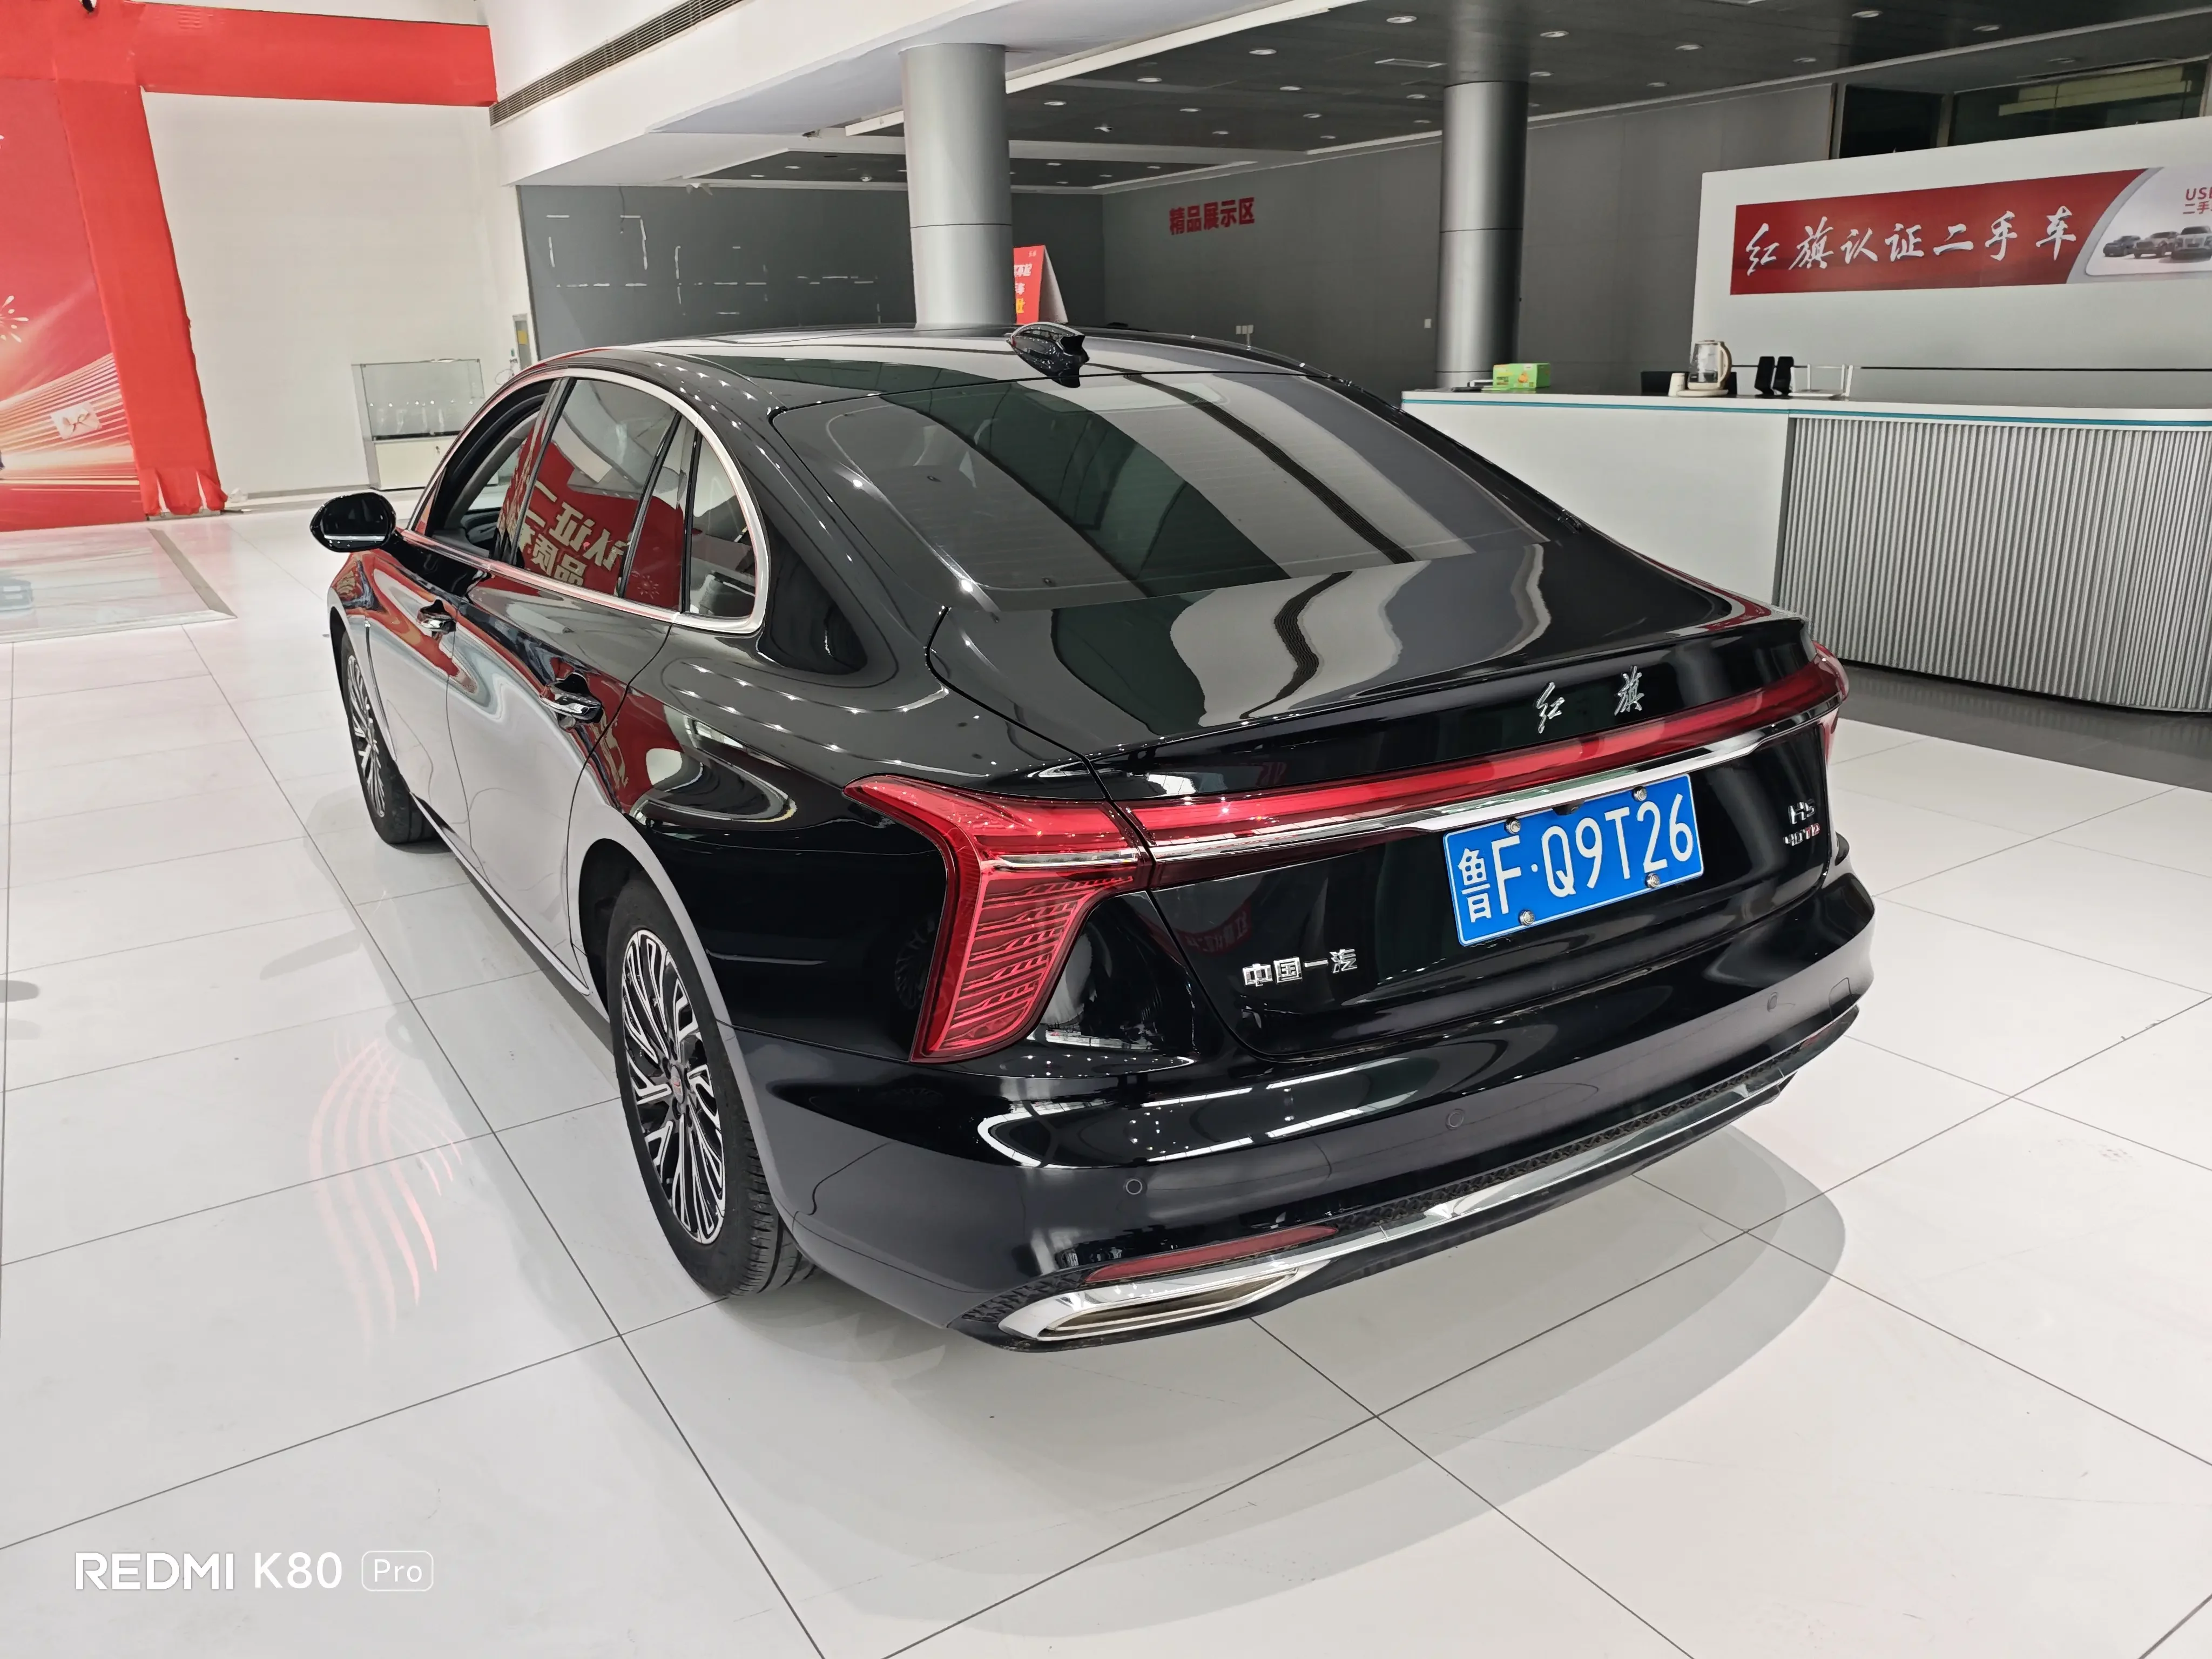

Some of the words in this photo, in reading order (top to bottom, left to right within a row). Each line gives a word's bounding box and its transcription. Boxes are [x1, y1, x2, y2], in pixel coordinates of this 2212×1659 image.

[1169, 197, 1255, 235] 精品展示区
[1745, 205, 2077, 277] 红旗认证二手车
[1534, 666, 1645, 734] 红旗
[1788, 798, 1816, 825] H5
[1458, 793, 1694, 923] 鲁F·Q9T26
[1242, 948, 1358, 987] 中国一汽
